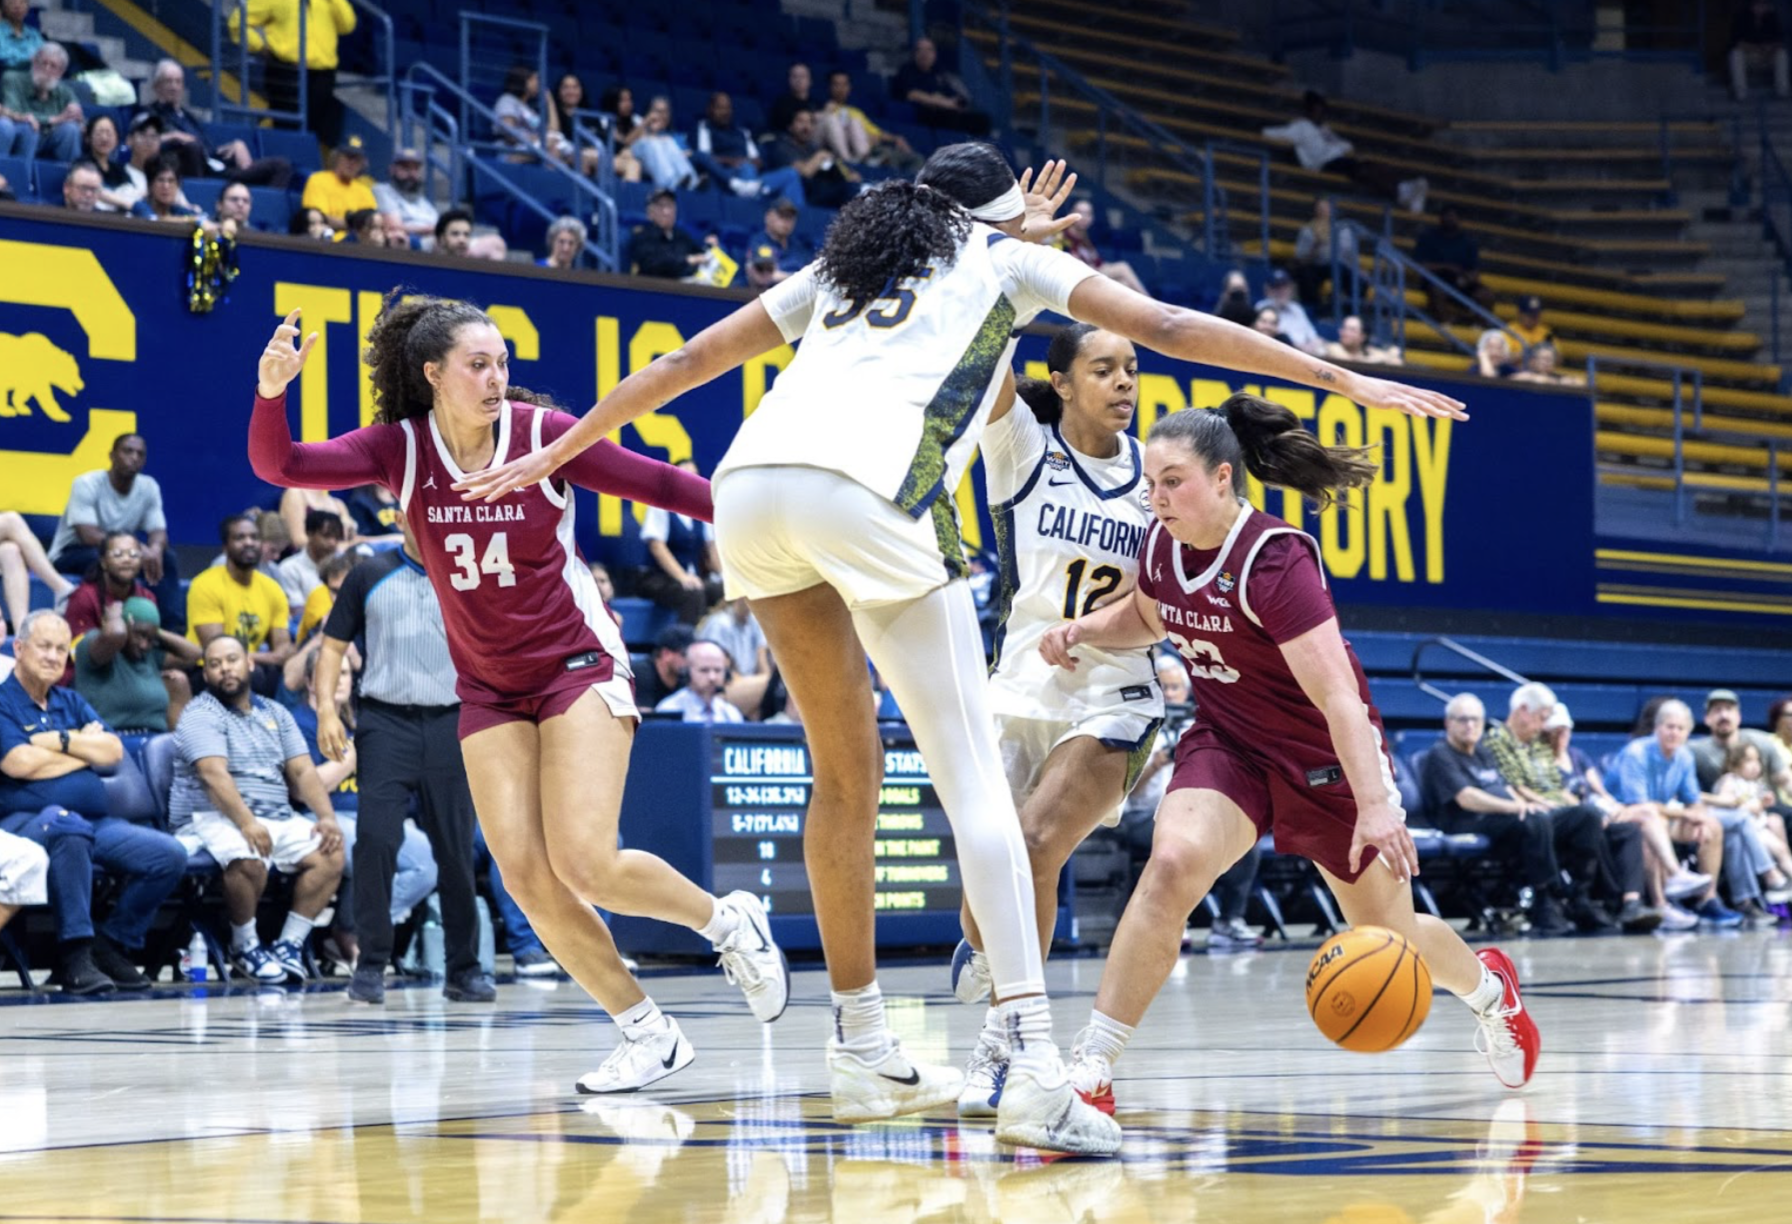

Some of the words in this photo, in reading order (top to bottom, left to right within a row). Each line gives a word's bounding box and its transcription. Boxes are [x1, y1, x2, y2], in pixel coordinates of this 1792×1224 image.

[428, 506, 472, 523] SANTA
[477, 505, 525, 522] CLARA
[1037, 503, 1147, 560] CALIFORNI
[444, 532, 517, 591] 34
[1062, 557, 1123, 620] 12
[1186, 611, 1234, 632] CLARA
[724, 747, 806, 775] CALIFORNIA
